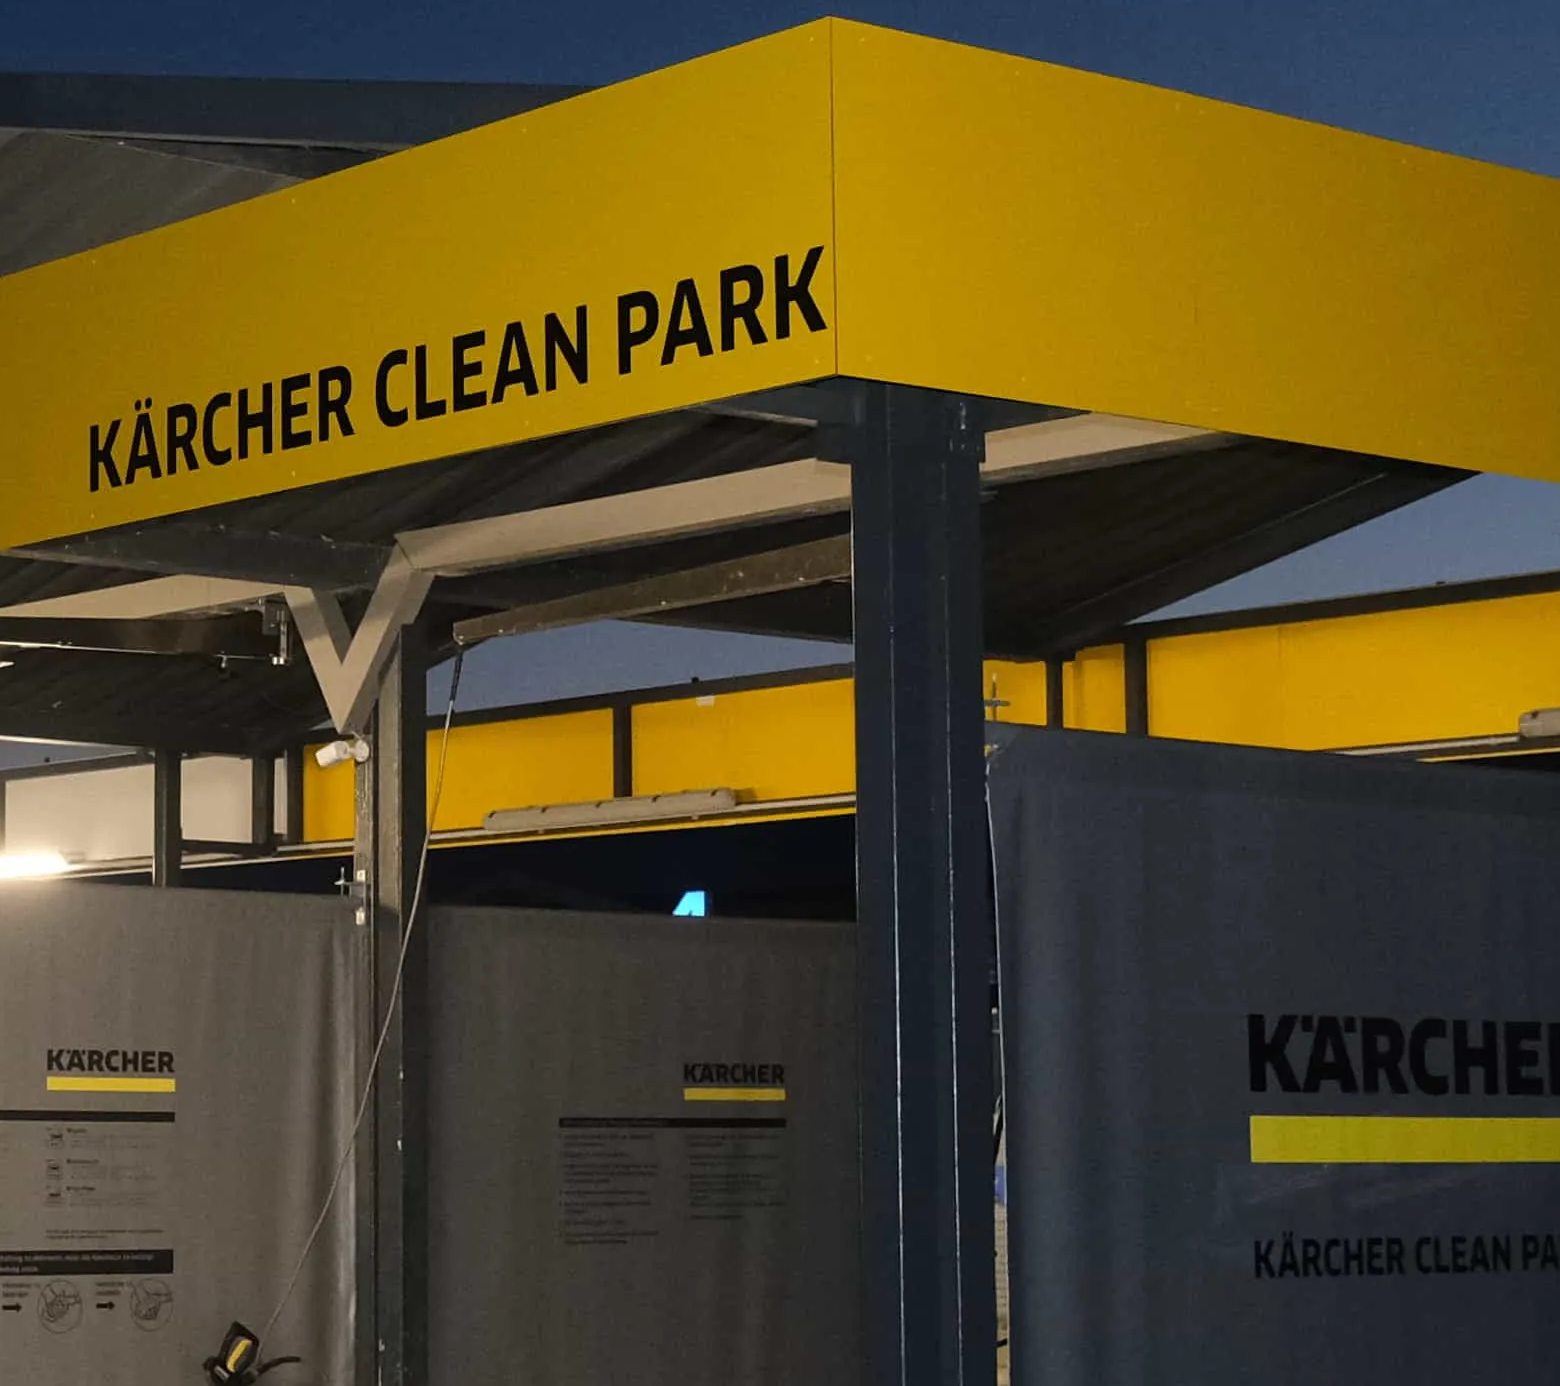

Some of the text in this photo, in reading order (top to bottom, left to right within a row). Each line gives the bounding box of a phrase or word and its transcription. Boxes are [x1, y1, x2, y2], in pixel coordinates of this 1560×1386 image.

[87, 246, 828, 492] KÄRCHER CLEAN PARK
[46, 1049, 176, 1073] KÄRCHER
[683, 1062, 785, 1085] KÄRCHER
[1253, 1230, 1406, 1278] KÄRCHER
[1415, 1234, 1512, 1275] CLEAN
